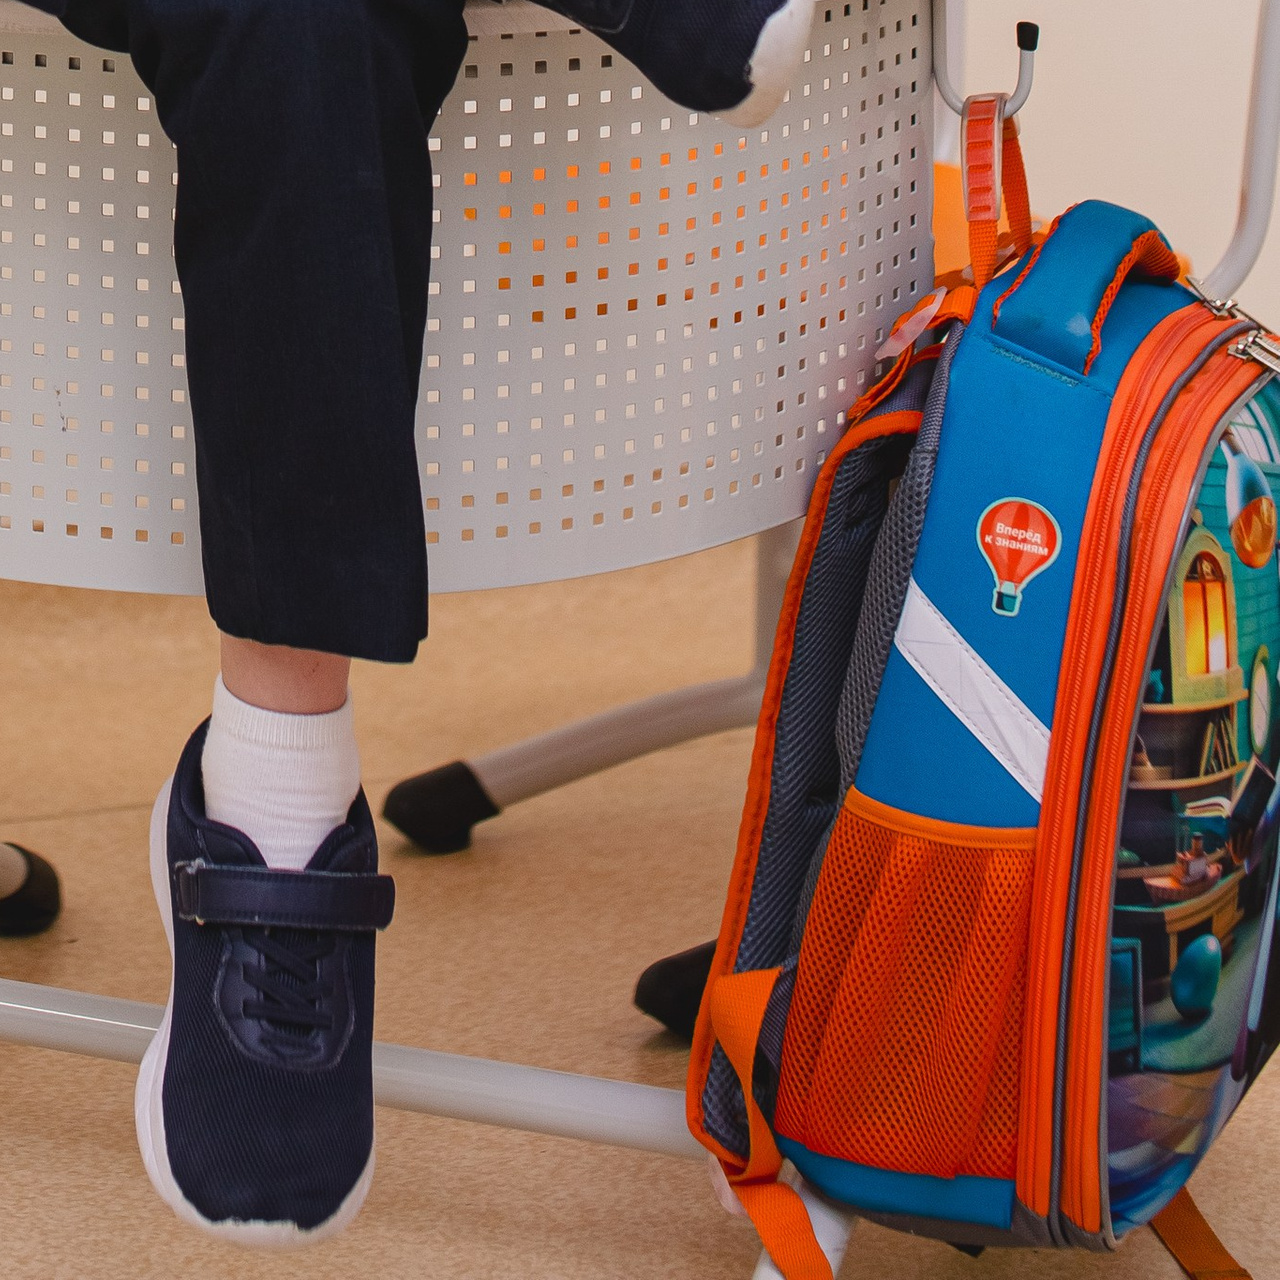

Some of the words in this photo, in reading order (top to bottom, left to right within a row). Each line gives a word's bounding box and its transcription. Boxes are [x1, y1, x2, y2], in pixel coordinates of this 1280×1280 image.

[996, 522, 1042, 545] Вперёд
[984, 534, 993, 544] к
[995, 536, 1049, 556] знаниям
